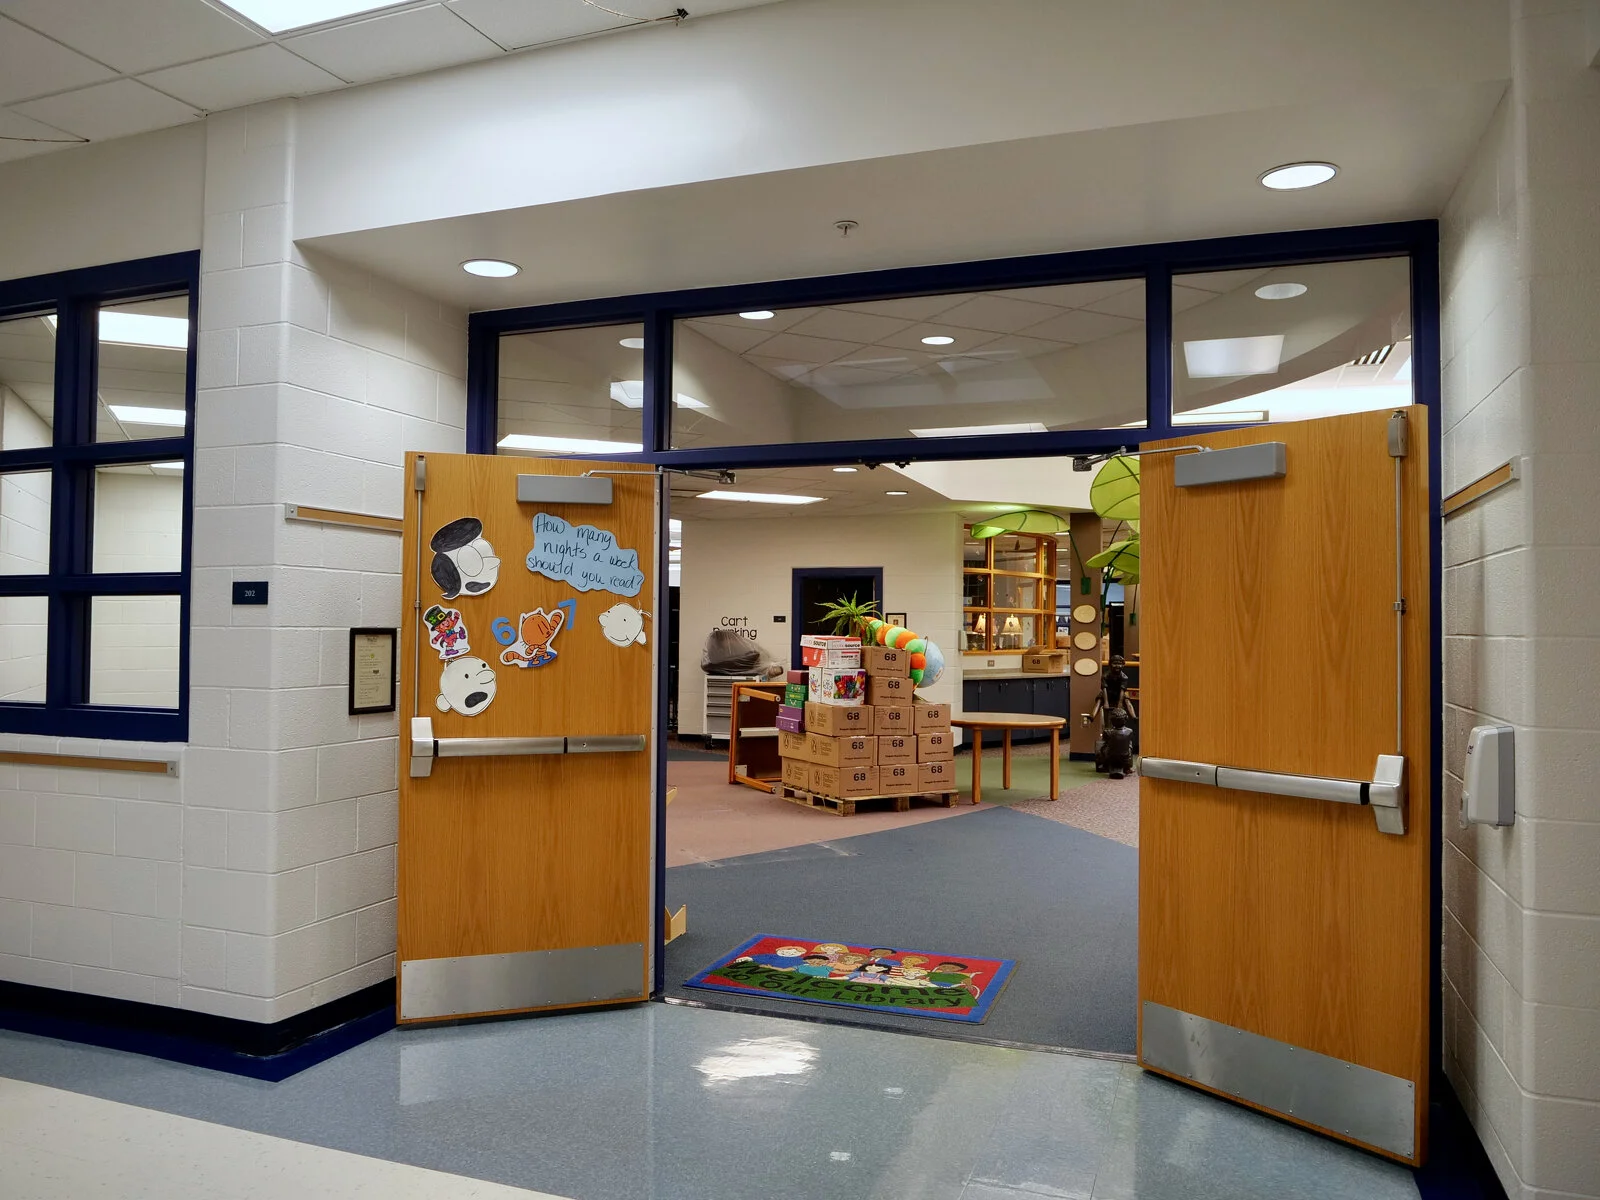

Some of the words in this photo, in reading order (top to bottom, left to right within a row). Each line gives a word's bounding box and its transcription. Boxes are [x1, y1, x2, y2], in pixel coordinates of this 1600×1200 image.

[535, 515, 566, 534] How
[577, 527, 612, 551] many
[543, 540, 587, 561] nights
[593, 553, 604, 563] a
[609, 554, 637, 571] week
[527, 556, 574, 576] should
[581, 570, 605, 588] you
[609, 574, 644, 590] read?
[491, 616, 517, 646] 6
[557, 597, 577, 631] 7
[720, 616, 748, 627] Cart
[884, 653, 897, 661] 68
[888, 681, 900, 689] 68
[847, 712, 860, 720] 68
[888, 712, 901, 720] 68
[927, 710, 939, 718] 68
[851, 741, 864, 749] 68
[892, 739, 904, 747] 68
[893, 768, 905, 776] 68
[931, 765, 943, 773] 68
[853, 773, 866, 781] 68
[727, 959, 965, 997] Welcome
[831, 991, 963, 1008] Library
